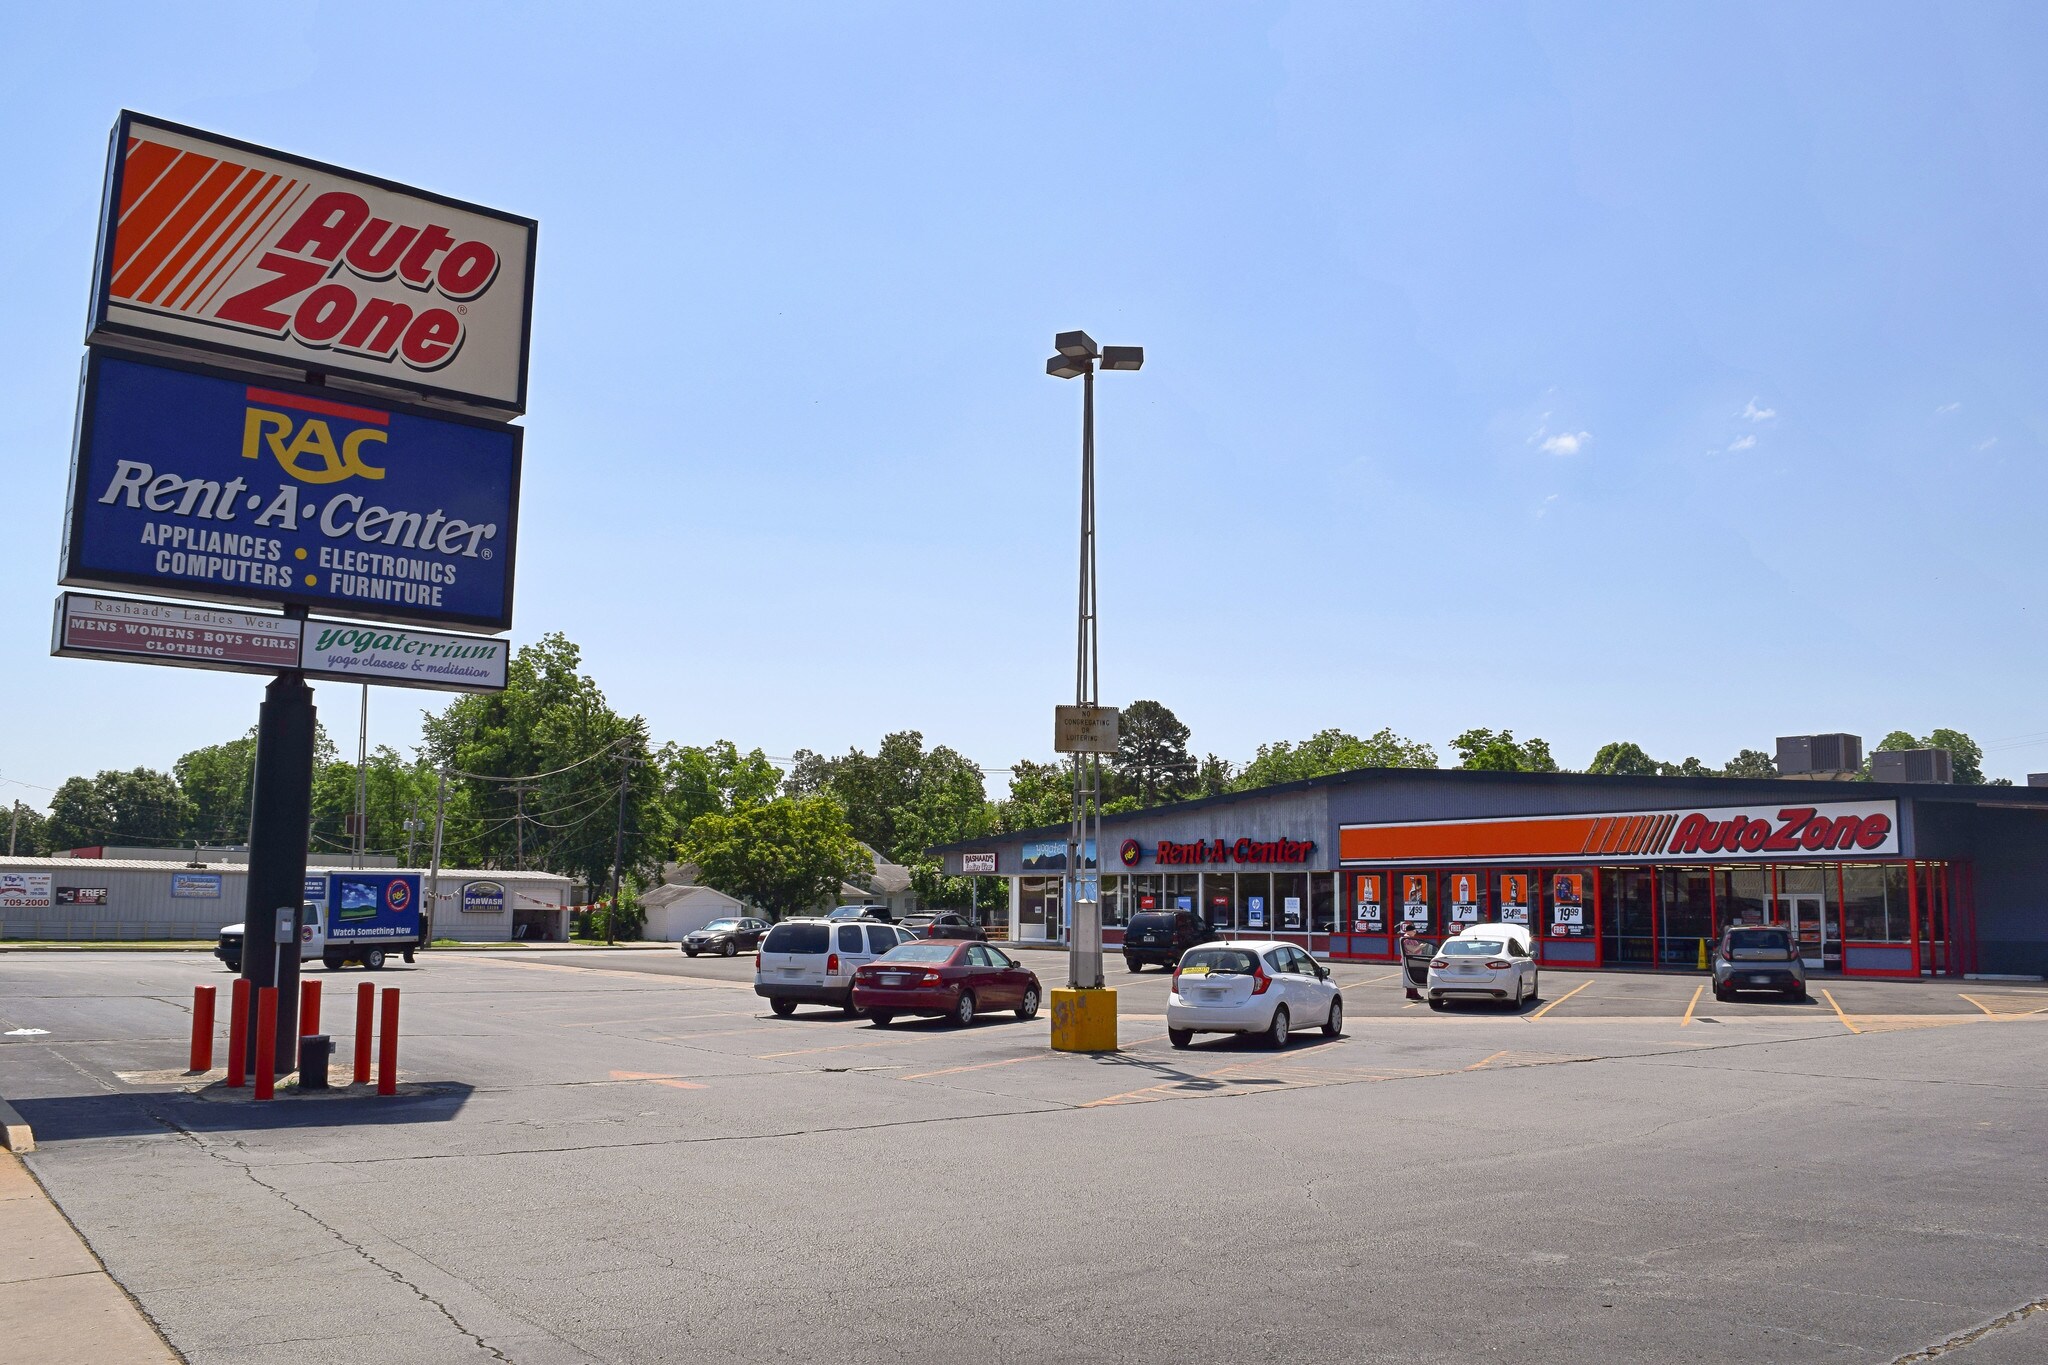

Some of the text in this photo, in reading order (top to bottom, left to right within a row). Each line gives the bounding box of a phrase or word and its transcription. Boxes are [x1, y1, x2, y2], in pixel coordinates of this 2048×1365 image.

[275, 191, 500, 300] Auto
[214, 252, 466, 371] Zone
[241, 407, 388, 484] RAC
[141, 522, 456, 584] APPLIANCES ELECTRONICS
[156, 550, 442, 607] COMPUTERS FURNITURE
[94, 600, 280, 630] Rashaad's Ladies Wear
[71, 618, 296, 650] MENS WOMENS BOYS GIRLS
[146, 640, 224, 656] CLOTHING
[315, 628, 498, 660] yogaterrium
[328, 653, 490, 678] yoga classes & meditation
[1668, 807, 1891, 854] AutoZone
[80, 889, 107, 897] FREE
[333, 928, 356, 936] Watch
[357, 927, 394, 936] Something
[1553, 925, 1566, 934] FREE
